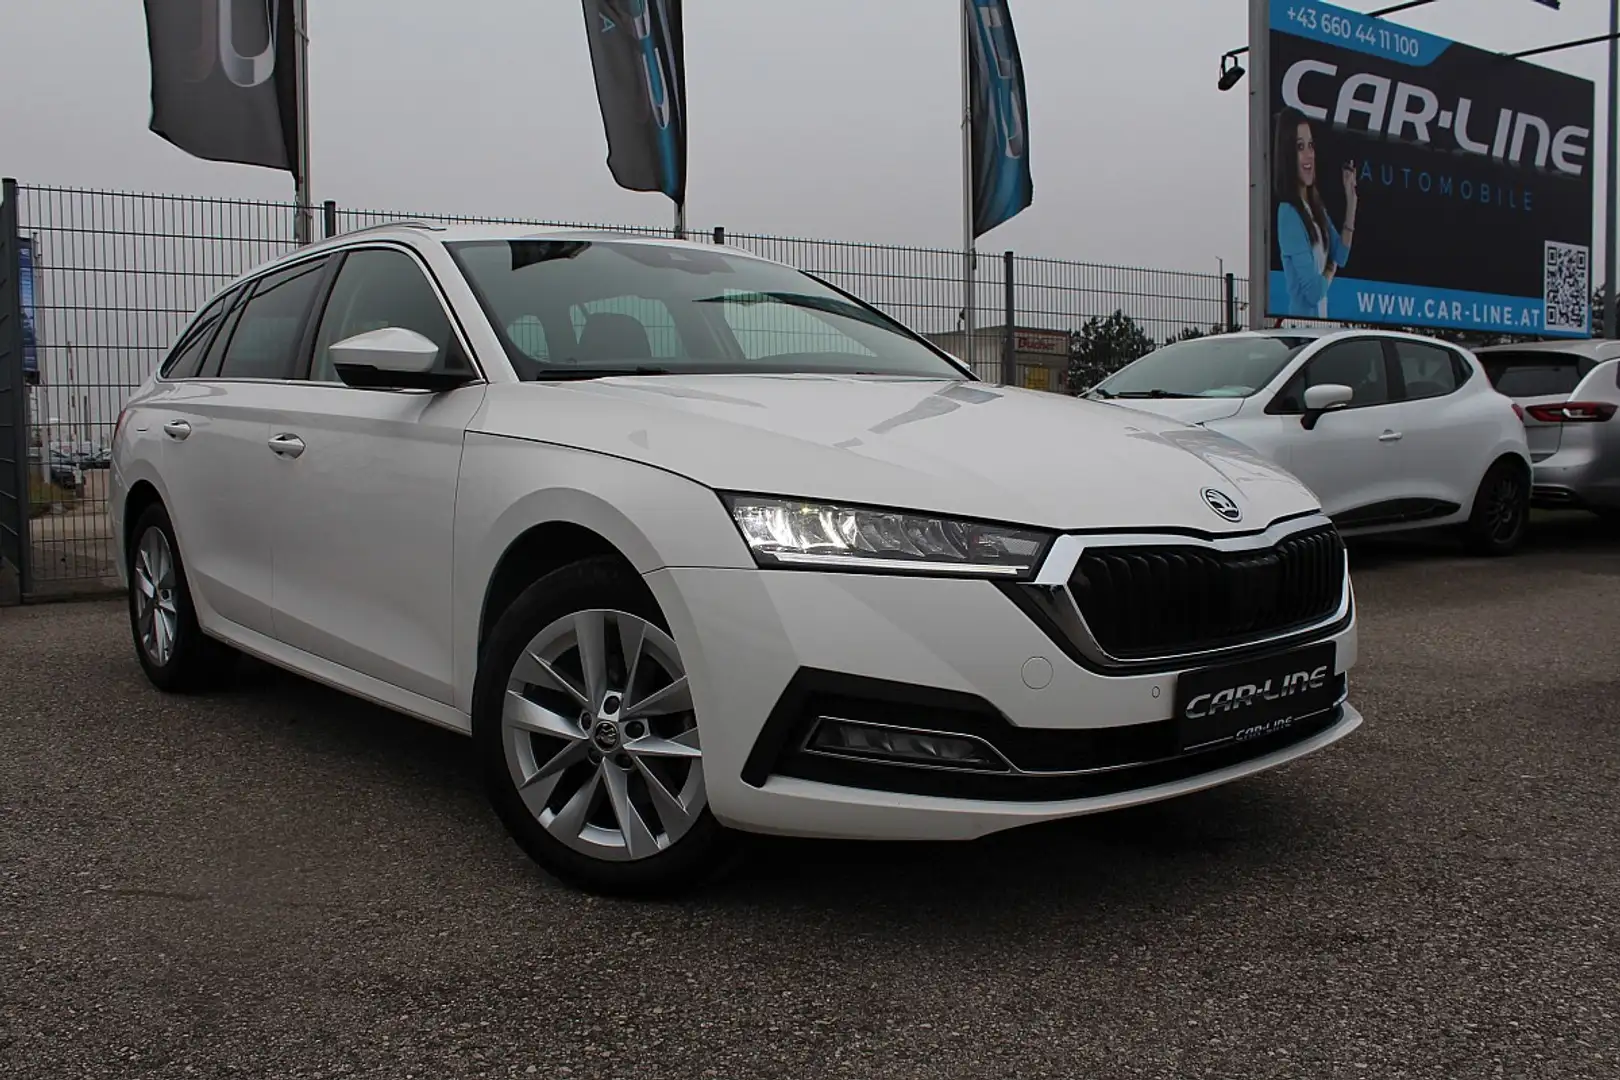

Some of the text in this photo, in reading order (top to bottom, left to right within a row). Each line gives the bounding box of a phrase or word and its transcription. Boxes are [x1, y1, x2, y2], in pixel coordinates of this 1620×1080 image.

[1287, 6, 1420, 58] +43 660 44 11 100
[1360, 160, 1533, 211] AUTOMOBILE
[1357, 291, 1540, 328] WWW.CAR-LINE.AT
